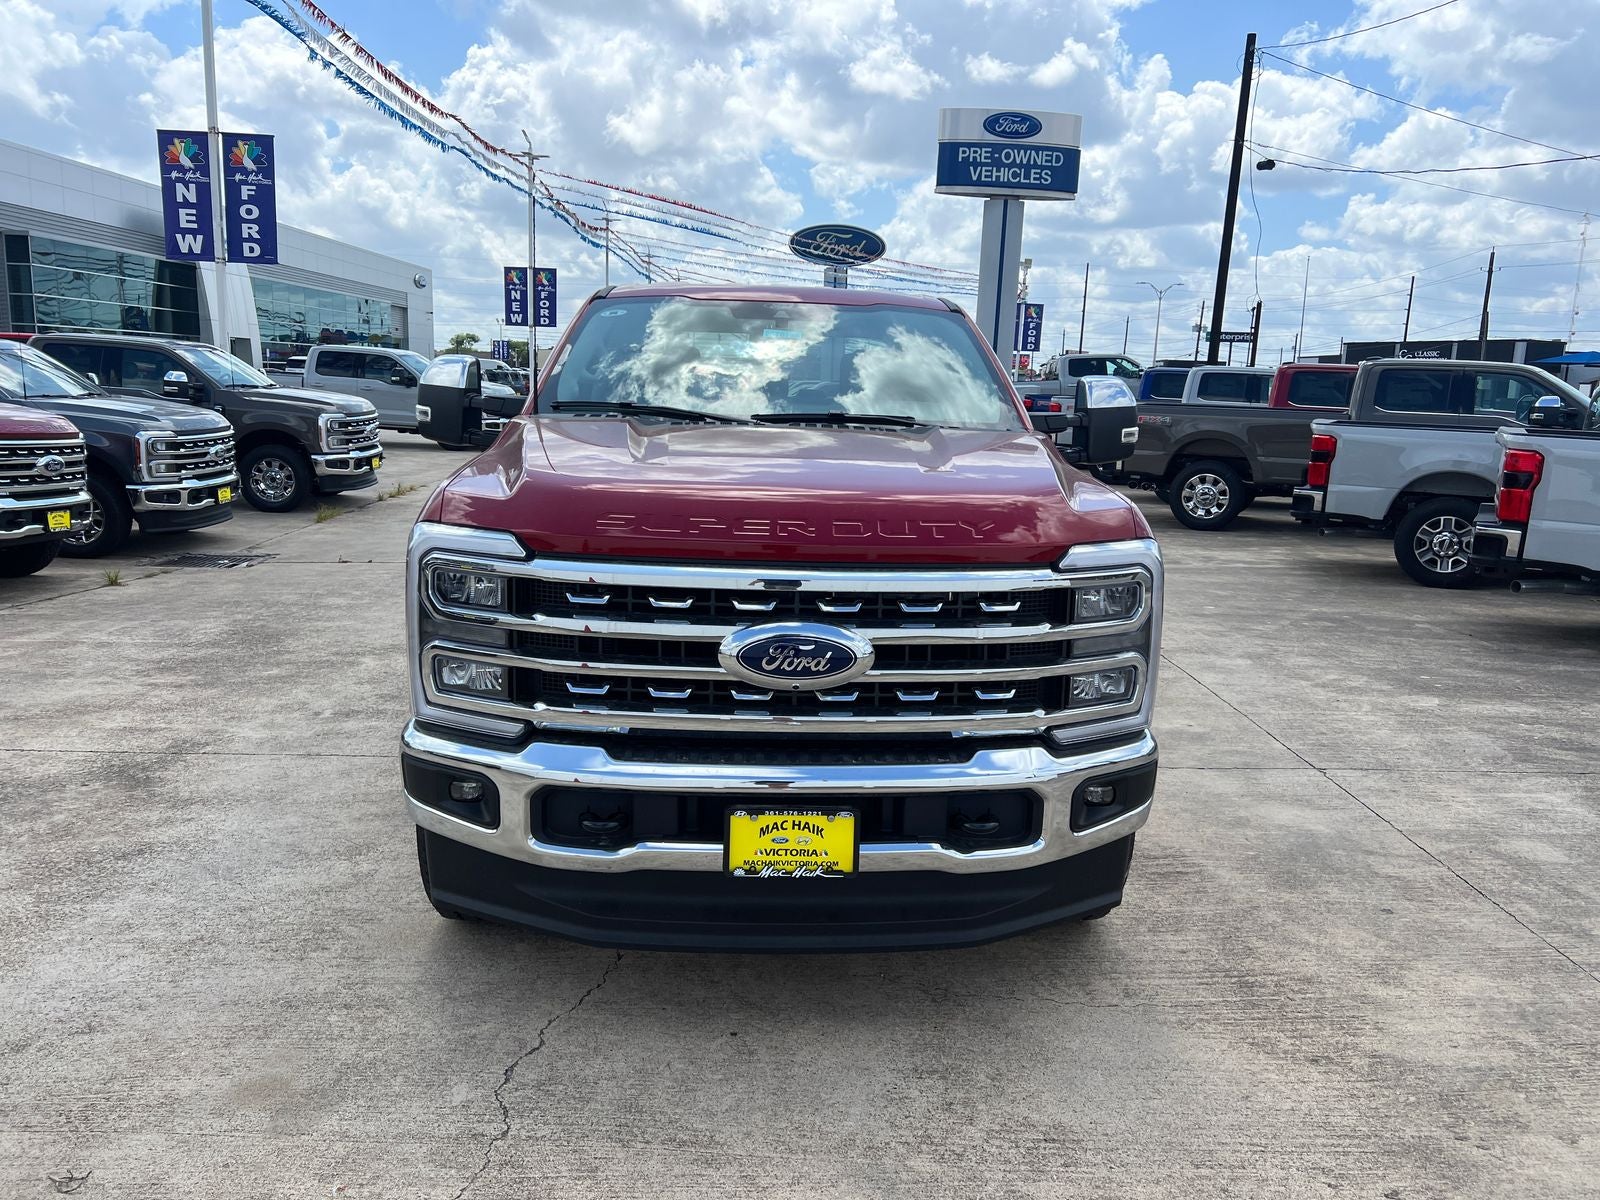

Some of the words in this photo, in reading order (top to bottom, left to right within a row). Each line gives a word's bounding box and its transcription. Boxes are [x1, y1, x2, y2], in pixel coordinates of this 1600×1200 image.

[995, 115, 1030, 133] Ford
[969, 166, 1052, 185] VEHICLES
[175, 182, 204, 255] NEW
[239, 185, 260, 257] FORD
[810, 231, 867, 257] Ford
[510, 291, 522, 323] NEW
[540, 291, 549, 324] FORD
[1026, 322, 1037, 350] FORD
[1220, 333, 1254, 342] terpris
[1414, 350, 1441, 358] CLASSIC
[1138, 415, 1171, 424] FX4
[595, 514, 816, 537] SUPER
[831, 519, 996, 539] DUTY
[761, 642, 833, 672] Ford
[759, 820, 789, 838] MAC
[791, 820, 824, 839] HAIK
[764, 848, 819, 857] VICTORIA
[743, 859, 840, 868] MACHAIKVICTORIA.COM
[757, 865, 791, 879] Mac
[791, 865, 833, 878] Haik
